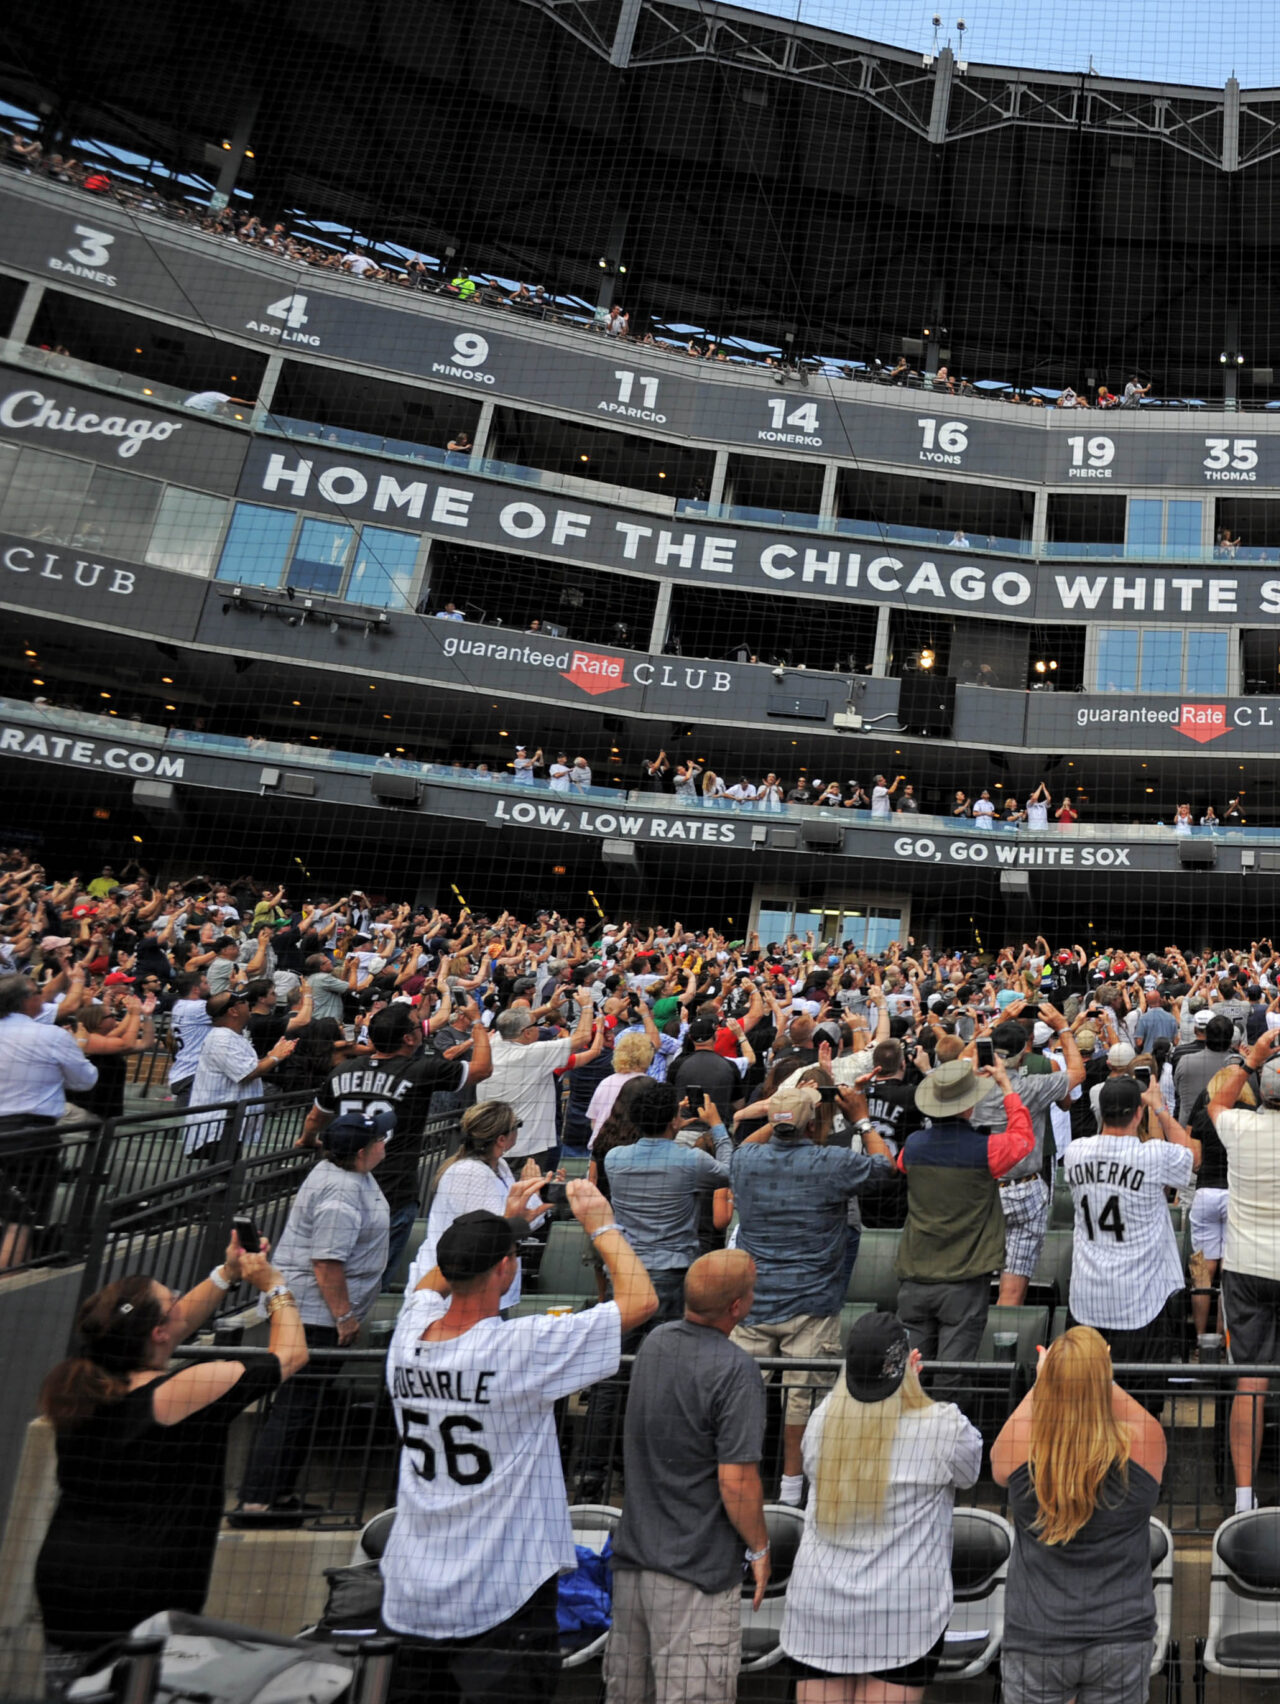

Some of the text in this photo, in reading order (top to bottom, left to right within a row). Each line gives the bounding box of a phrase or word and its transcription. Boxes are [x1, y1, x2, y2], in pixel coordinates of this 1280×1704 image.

[67, 224, 115, 267] 3
[49, 257, 118, 287] BAINES
[266, 294, 309, 329] 4
[245, 320, 321, 347] APPLING
[450, 332, 488, 366] 9
[432, 362, 496, 386] MINOSO
[614, 370, 659, 409] 11
[0, 390, 182, 458] Chicago
[597, 399, 667, 424] APARICIO
[768, 398, 820, 434] 14
[758, 429, 823, 448] KONERKO
[918, 417, 968, 454] 16
[1067, 435, 1115, 468] 19
[919, 450, 962, 465] LYONS
[1203, 438, 1258, 470] 35
[1068, 467, 1113, 478] PIERCE
[1204, 470, 1257, 481] THOMAS
[261, 453, 474, 527] HOME
[499, 502, 592, 546] OF
[615, 521, 737, 574] THE
[759, 543, 1031, 607] CHICAGO
[1055, 575, 1238, 613] WHITE
[4, 548, 136, 594] CLUB
[443, 637, 732, 692] guaranteed Rate CLUB
[1077, 707, 1179, 726] guaranteed
[1183, 707, 1223, 724] Rate
[0, 728, 185, 778] RATE.COM
[494, 800, 736, 842] LOW, LOW RATES
[894, 837, 1131, 867] GO, GO WHITE SOX
[331, 1071, 413, 1101] BUEHRLE
[1067, 1161, 1144, 1191] KONERKO
[1080, 1195, 1124, 1242] 14
[402, 1407, 493, 1486] 56
